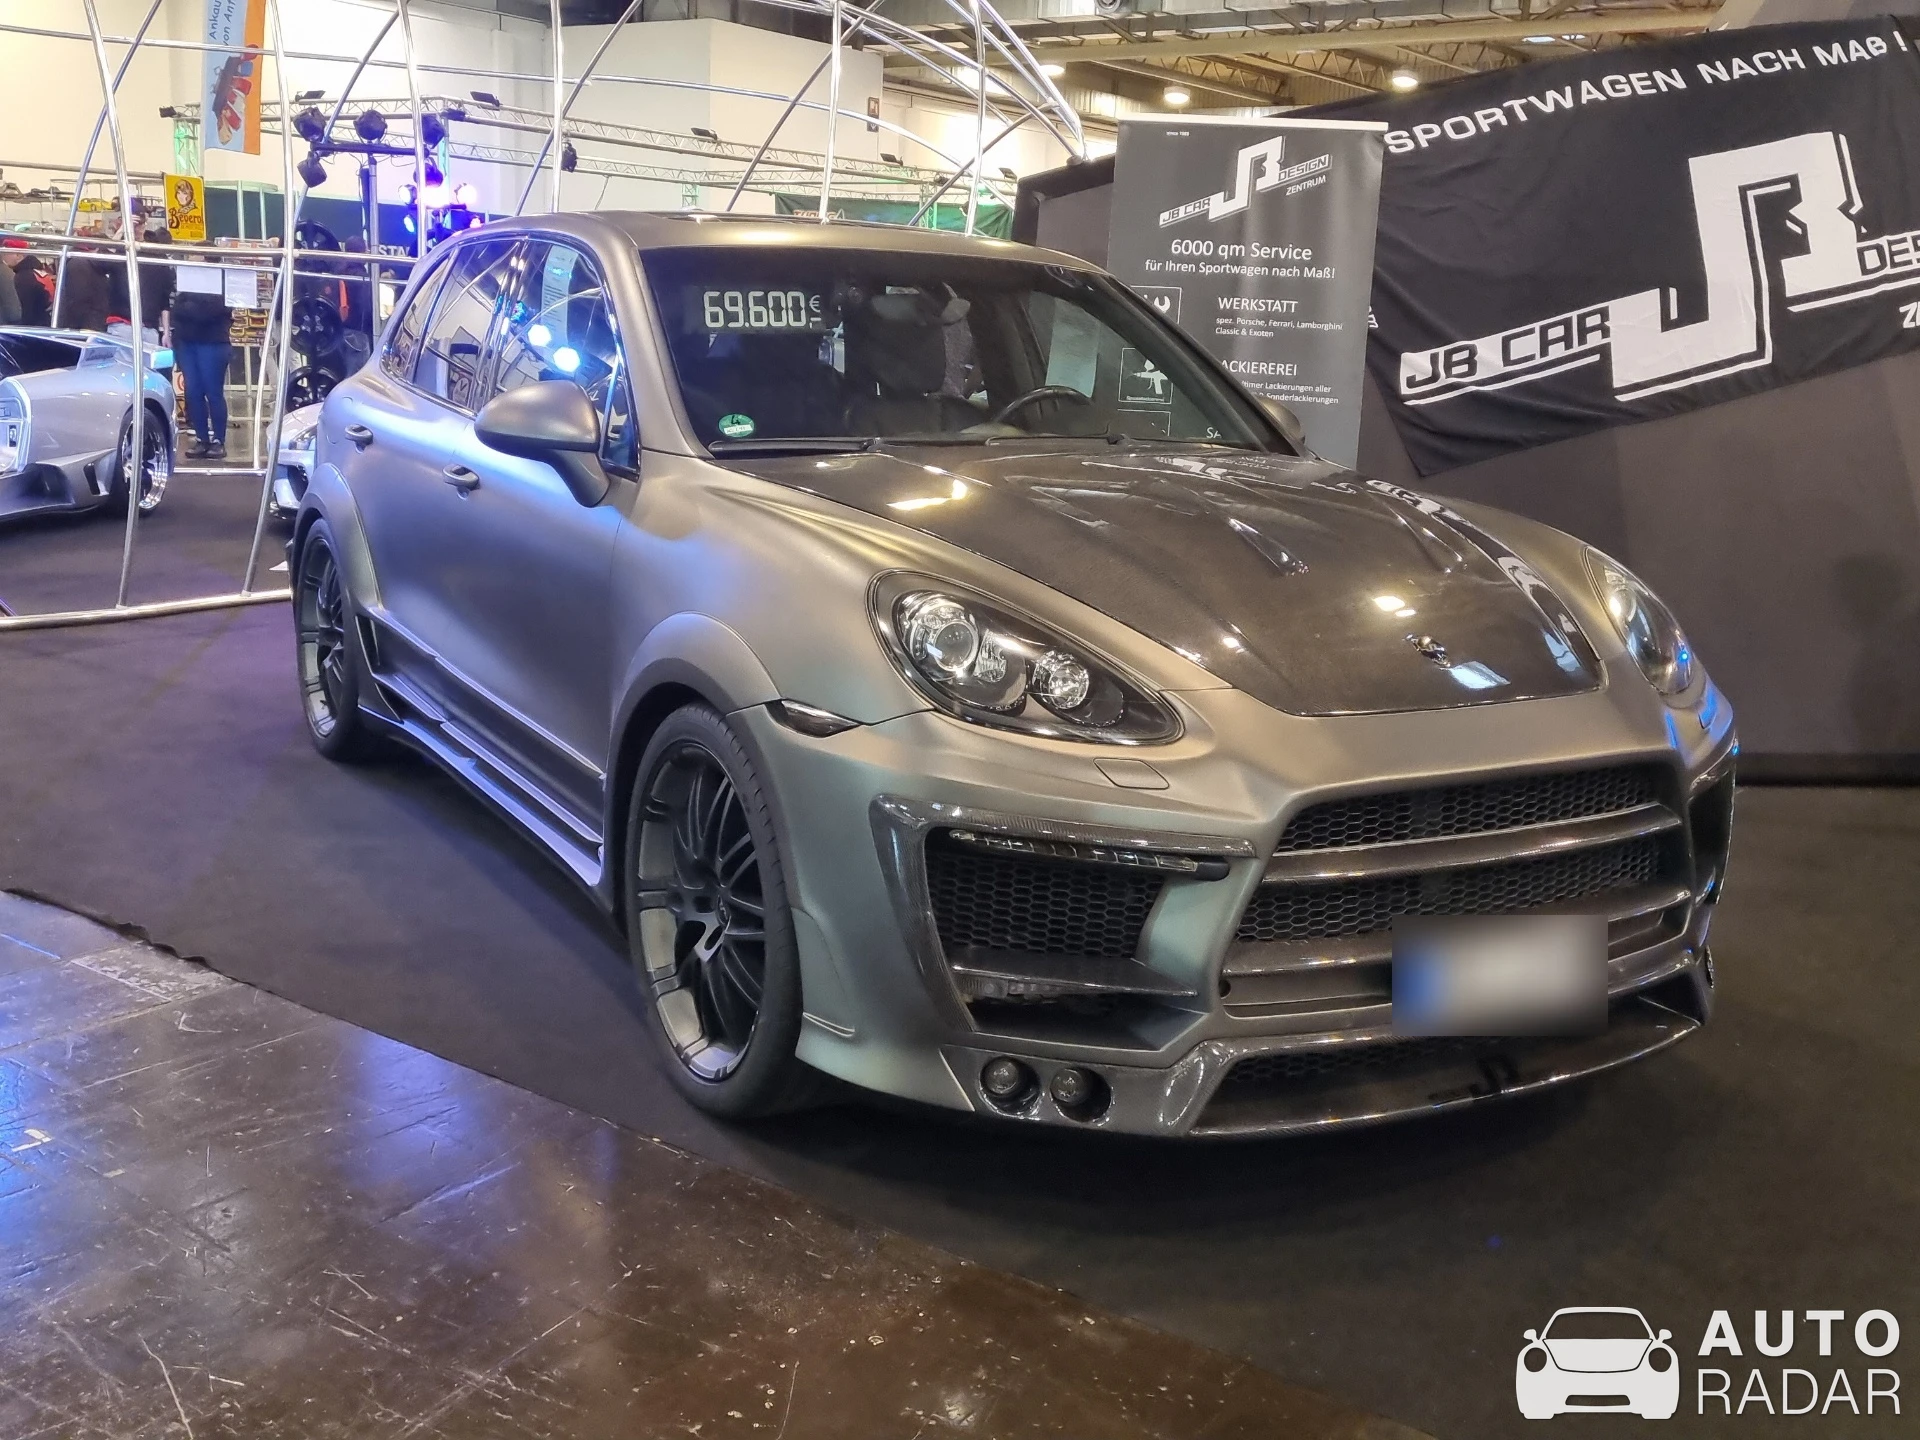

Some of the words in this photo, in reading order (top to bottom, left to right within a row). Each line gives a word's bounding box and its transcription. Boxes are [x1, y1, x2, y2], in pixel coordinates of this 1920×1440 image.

[1383, 68, 1688, 153] SPORTWAGEN
[1696, 48, 1806, 84] NACH
[1278, 158, 1328, 182] DESIGN
[1286, 175, 1327, 196] ZENTRUM
[1162, 208, 1181, 223] JB
[1184, 197, 1211, 215] CAR
[1171, 239, 1214, 256] 6000
[1218, 243, 1246, 259] qm
[1250, 242, 1313, 260] Service
[1145, 259, 1162, 272] für
[1165, 260, 1196, 273] Ihren
[1199, 261, 1269, 276] Sportwagen
[1272, 265, 1300, 277] nach
[1303, 266, 1336, 279] Maß!
[1218, 296, 1299, 313] WERKSTATT
[1215, 327, 1240, 336] Classic
[1241, 328, 1248, 336] &
[1249, 328, 1275, 338] Exoten
[1236, 317, 1267, 327] Porsche,
[1269, 319, 1295, 329] Ferrari,
[1297, 320, 1344, 331] Lamborghini
[1405, 343, 1479, 389] JB
[1501, 305, 1611, 367] CAR
[1221, 359, 1298, 376] ACKIEREREI
[1242, 379, 1264, 389] timer
[1265, 381, 1314, 393] Lackierungen
[1315, 384, 1332, 393] aller
